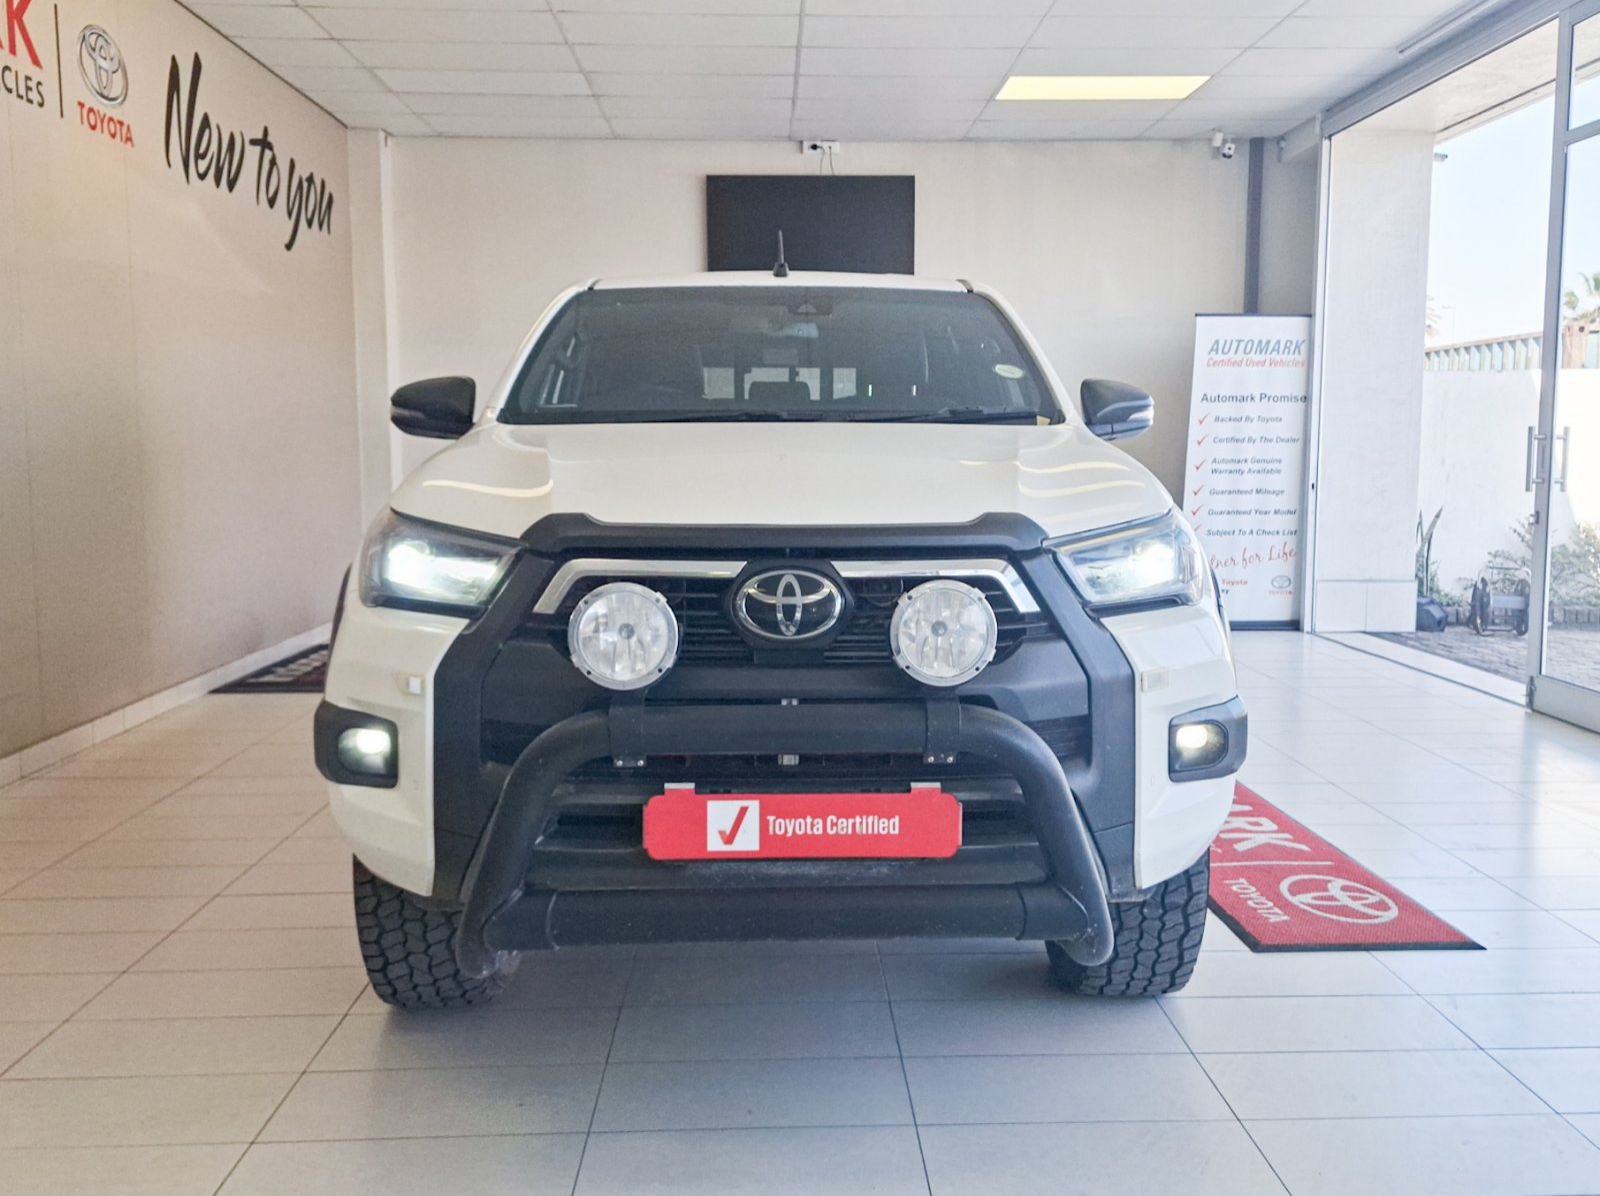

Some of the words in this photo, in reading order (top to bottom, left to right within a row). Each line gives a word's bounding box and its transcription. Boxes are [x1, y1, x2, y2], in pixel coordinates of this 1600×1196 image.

[77, 100, 134, 147] TOYOTA
[164, 52, 245, 193] New
[249, 125, 280, 209] to
[284, 157, 334, 251] you
[1208, 339, 1305, 355] AUTOMARK
[1206, 357, 1244, 368] Certified
[1245, 358, 1266, 368] Used
[1268, 358, 1306, 369] Vehicles
[1200, 393, 1256, 403] Automark
[1259, 393, 1308, 403] Promise
[1214, 415, 1243, 423] Backed
[1245, 415, 1255, 424] By
[1257, 415, 1283, 425] Toyota
[1213, 436, 1245, 444] Certified
[1247, 436, 1257, 445] By
[1259, 436, 1274, 444] The
[1275, 436, 1300, 444] Dealer
[1211, 457, 1248, 465] Automark
[1250, 457, 1282, 465] Genuine
[1211, 467, 1245, 476] Warranty
[1246, 467, 1282, 475] Available
[1208, 488, 1254, 496] Guaranteed
[1255, 487, 1285, 497] Mileage
[1207, 508, 1252, 516] Guaranteed
[1254, 508, 1272, 516] Year
[1273, 508, 1297, 516] Model
[1206, 528, 1236, 537] Subject
[1237, 528, 1247, 536] To
[1248, 528, 1255, 536] A
[1256, 528, 1280, 536] Check
[1281, 528, 1298, 536] List
[1241, 547, 1263, 569] for
[1267, 541, 1297, 563] Life
[766, 814, 822, 837] Toyota
[825, 814, 900, 836] Certified
[1223, 878, 1291, 924] TOYOTA
